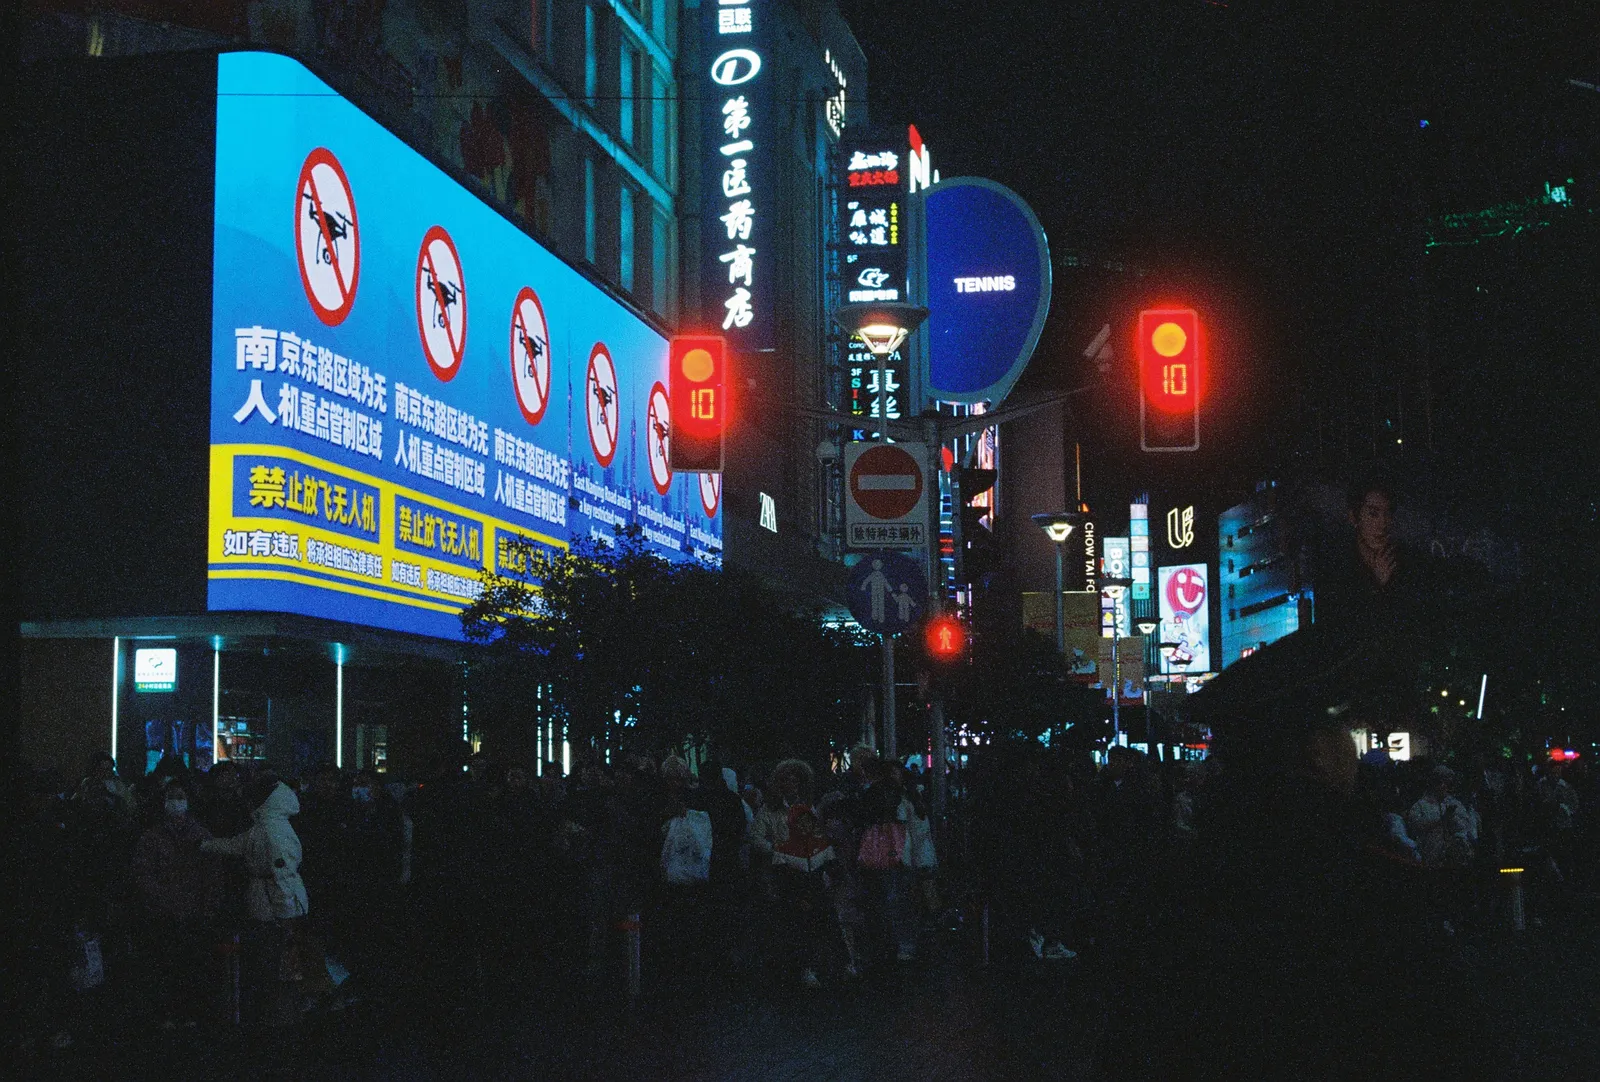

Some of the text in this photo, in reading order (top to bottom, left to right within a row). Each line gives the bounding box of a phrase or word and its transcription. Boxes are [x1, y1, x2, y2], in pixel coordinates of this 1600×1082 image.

[719, 95, 756, 331] 第一医药商店
[954, 275, 1016, 293] TENNIS
[234, 325, 388, 414] 南京东路区域为无
[850, 368, 862, 377] 3F
[1163, 364, 1187, 395] 10
[233, 380, 383, 461] 人机重点管制区域
[394, 382, 490, 456] 南京东路区域为无
[691, 388, 714, 420] 10
[394, 430, 486, 498] 人机重点管制区域
[494, 428, 568, 490] 南京东路区域为无
[248, 464, 376, 534] 禁止放飞无人机
[494, 470, 566, 528] 人机重点管制区域
[399, 506, 480, 562] 禁止放飞无人机
[854, 526, 920, 542] 除特种车辆外
[1084, 522, 1096, 593] CHOW TAI FO
